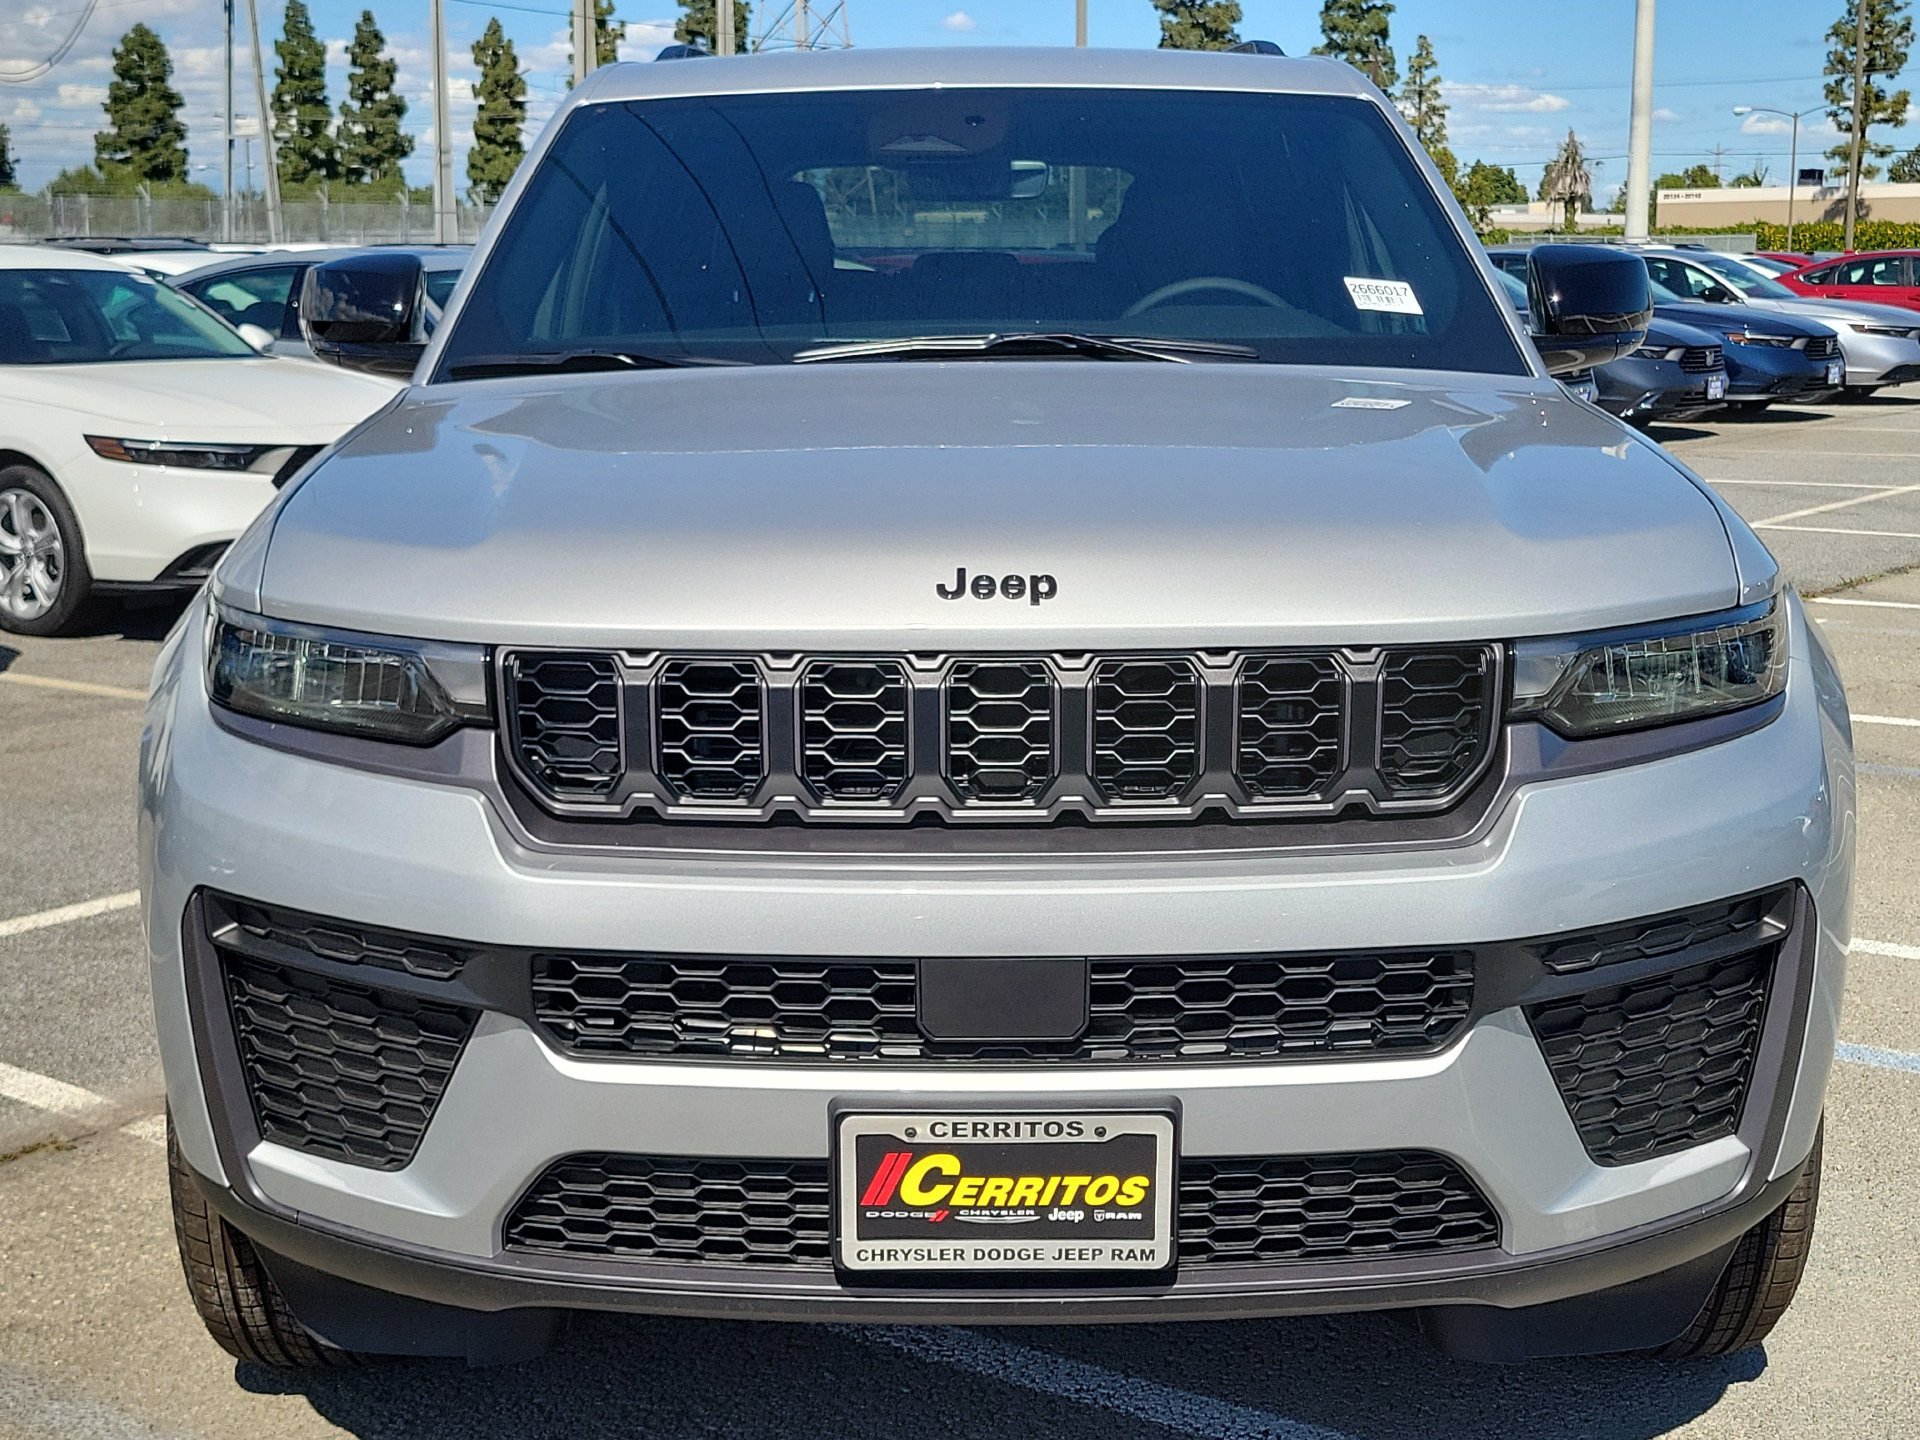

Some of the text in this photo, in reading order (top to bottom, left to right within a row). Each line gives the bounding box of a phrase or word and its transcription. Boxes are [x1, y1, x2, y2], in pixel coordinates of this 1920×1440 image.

[1349, 283, 1408, 297] 2666017
[936, 567, 1057, 606] Jeep
[929, 1121, 1084, 1138] CERRITOS
[899, 1153, 1150, 1207] CERRITOS
[1048, 1208, 1084, 1223] Jeep
[1105, 1212, 1142, 1220] RAM
[856, 1248, 1156, 1262] CHRYSLER DODGE JEEP RAM
